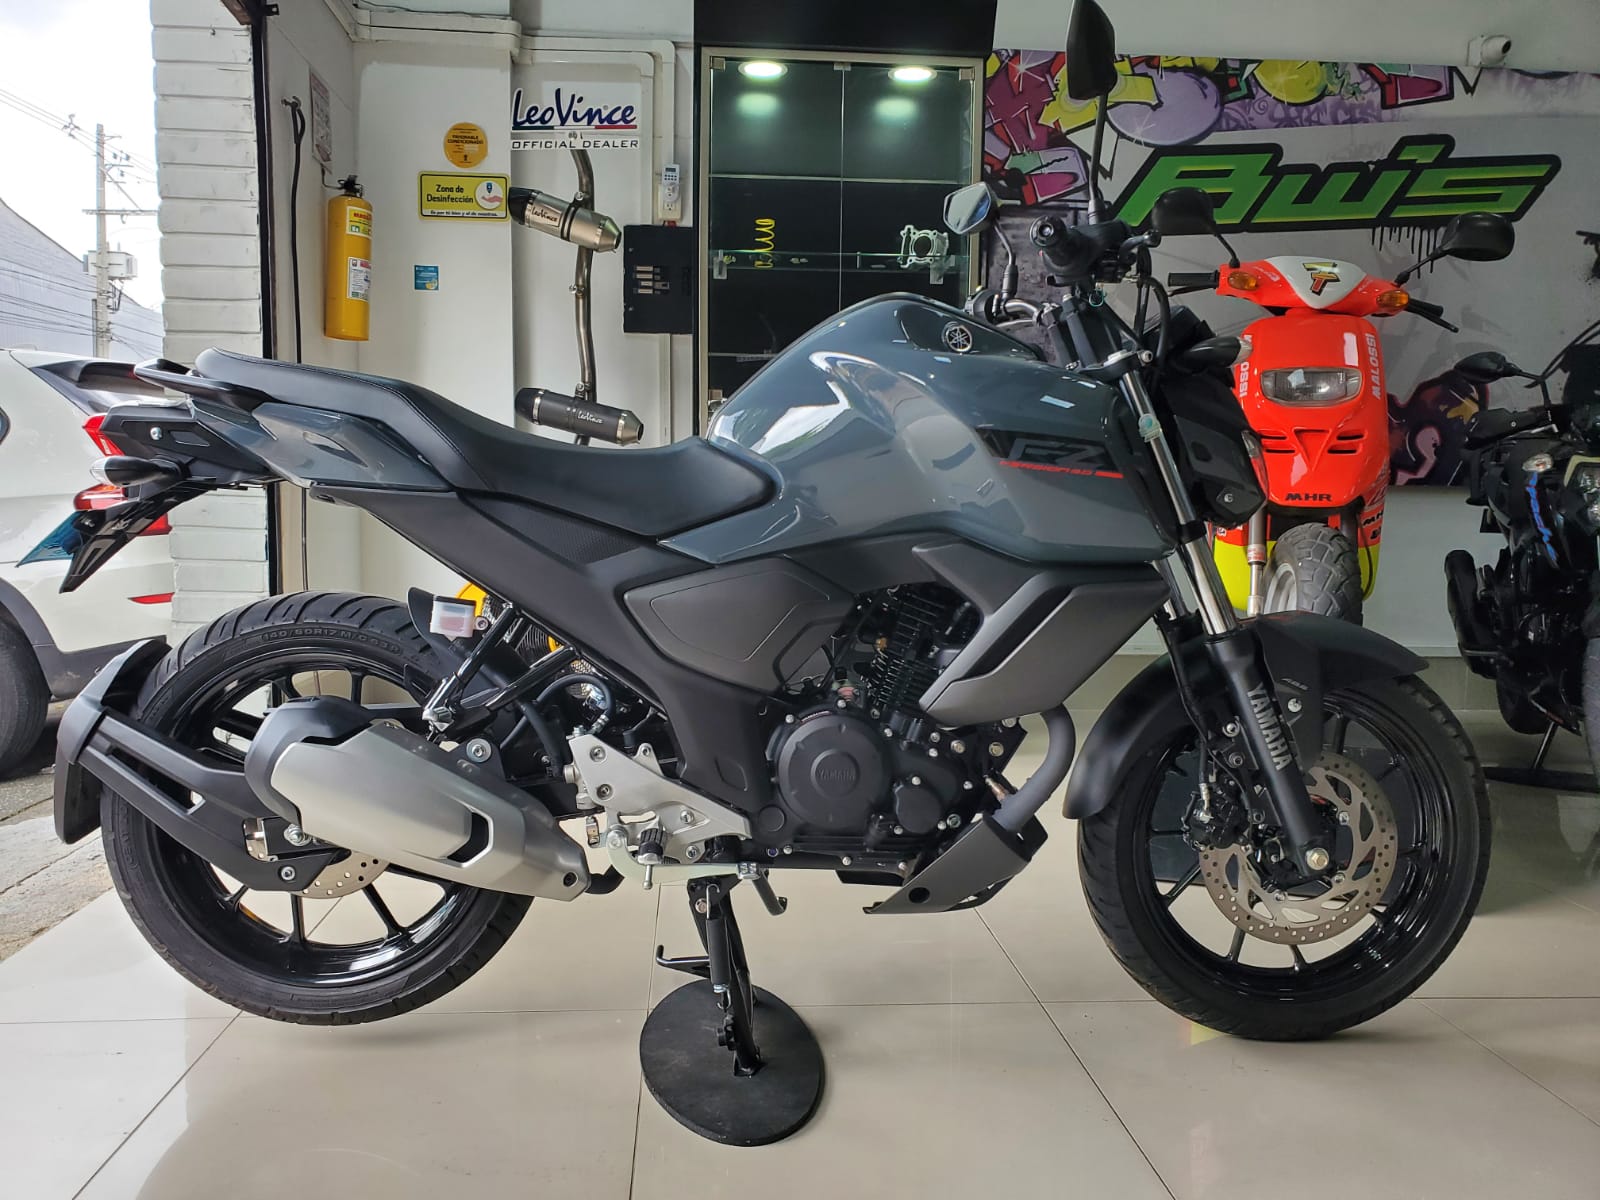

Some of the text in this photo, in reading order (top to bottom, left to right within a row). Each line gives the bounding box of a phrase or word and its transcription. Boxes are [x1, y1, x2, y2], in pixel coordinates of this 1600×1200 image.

[511, 88, 637, 126] LeoVince
[512, 140, 639, 149] OFFICIAL DEALER
[436, 184, 464, 193] Zona de
[426, 193, 474, 204] Desinfección
[1365, 333, 1381, 400] MALOSSI
[1285, 493, 1333, 502] MHR
[1247, 682, 1293, 770] YAMAHA
